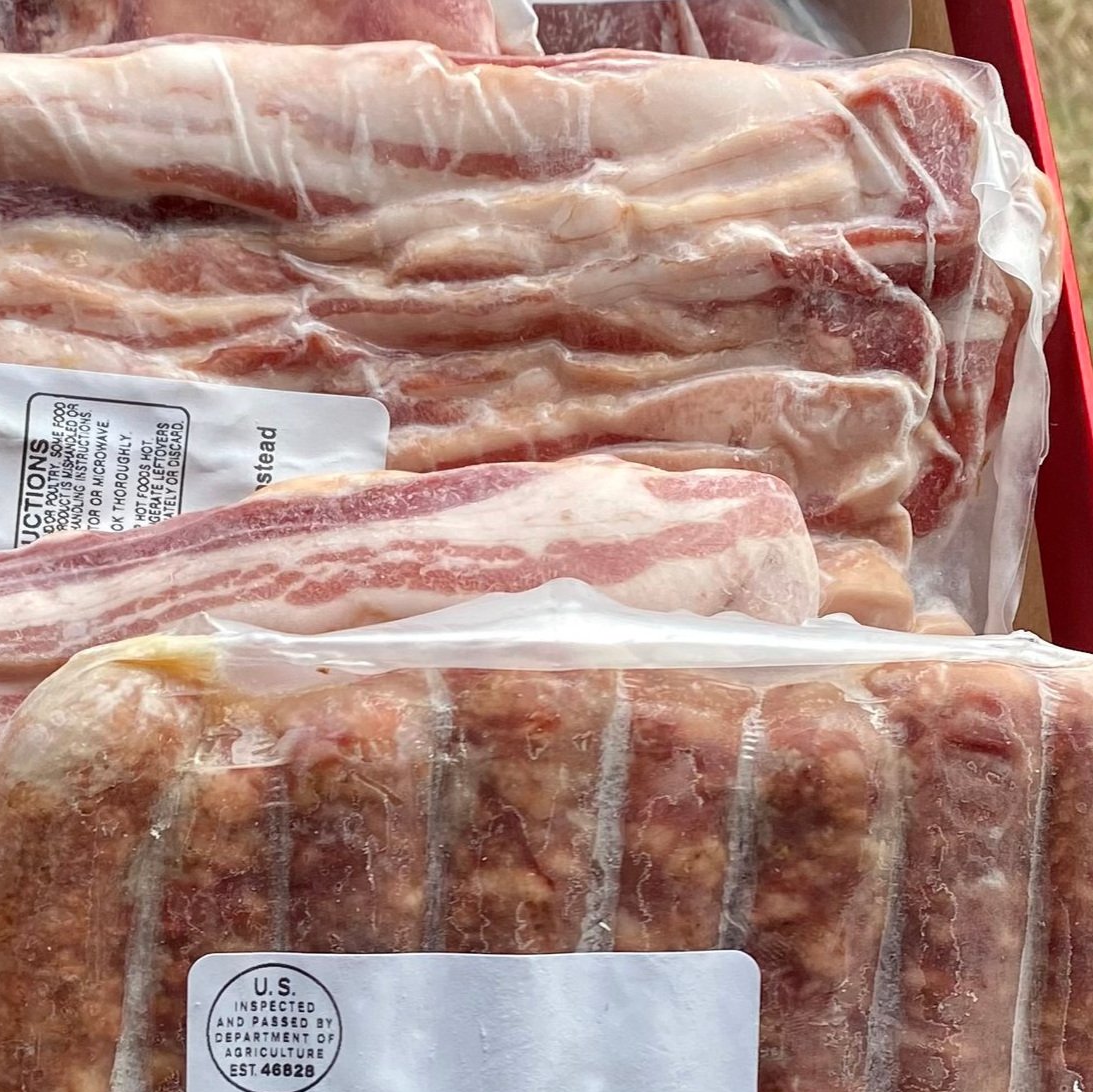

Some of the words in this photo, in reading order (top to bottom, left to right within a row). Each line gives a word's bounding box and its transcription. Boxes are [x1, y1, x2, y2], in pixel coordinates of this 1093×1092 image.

[235, 1000, 315, 1013] INSPECTED
[216, 1016, 245, 1027] AND
[252, 1016, 308, 1028] PASSED
[316, 1018, 333, 1029] BY
[215, 1032, 309, 1044] DEPARTMENT
[316, 1033, 335, 1044] OF
[225, 1047, 324, 1059] AGRICULTURE
[260, 1063, 315, 1078] 46828
